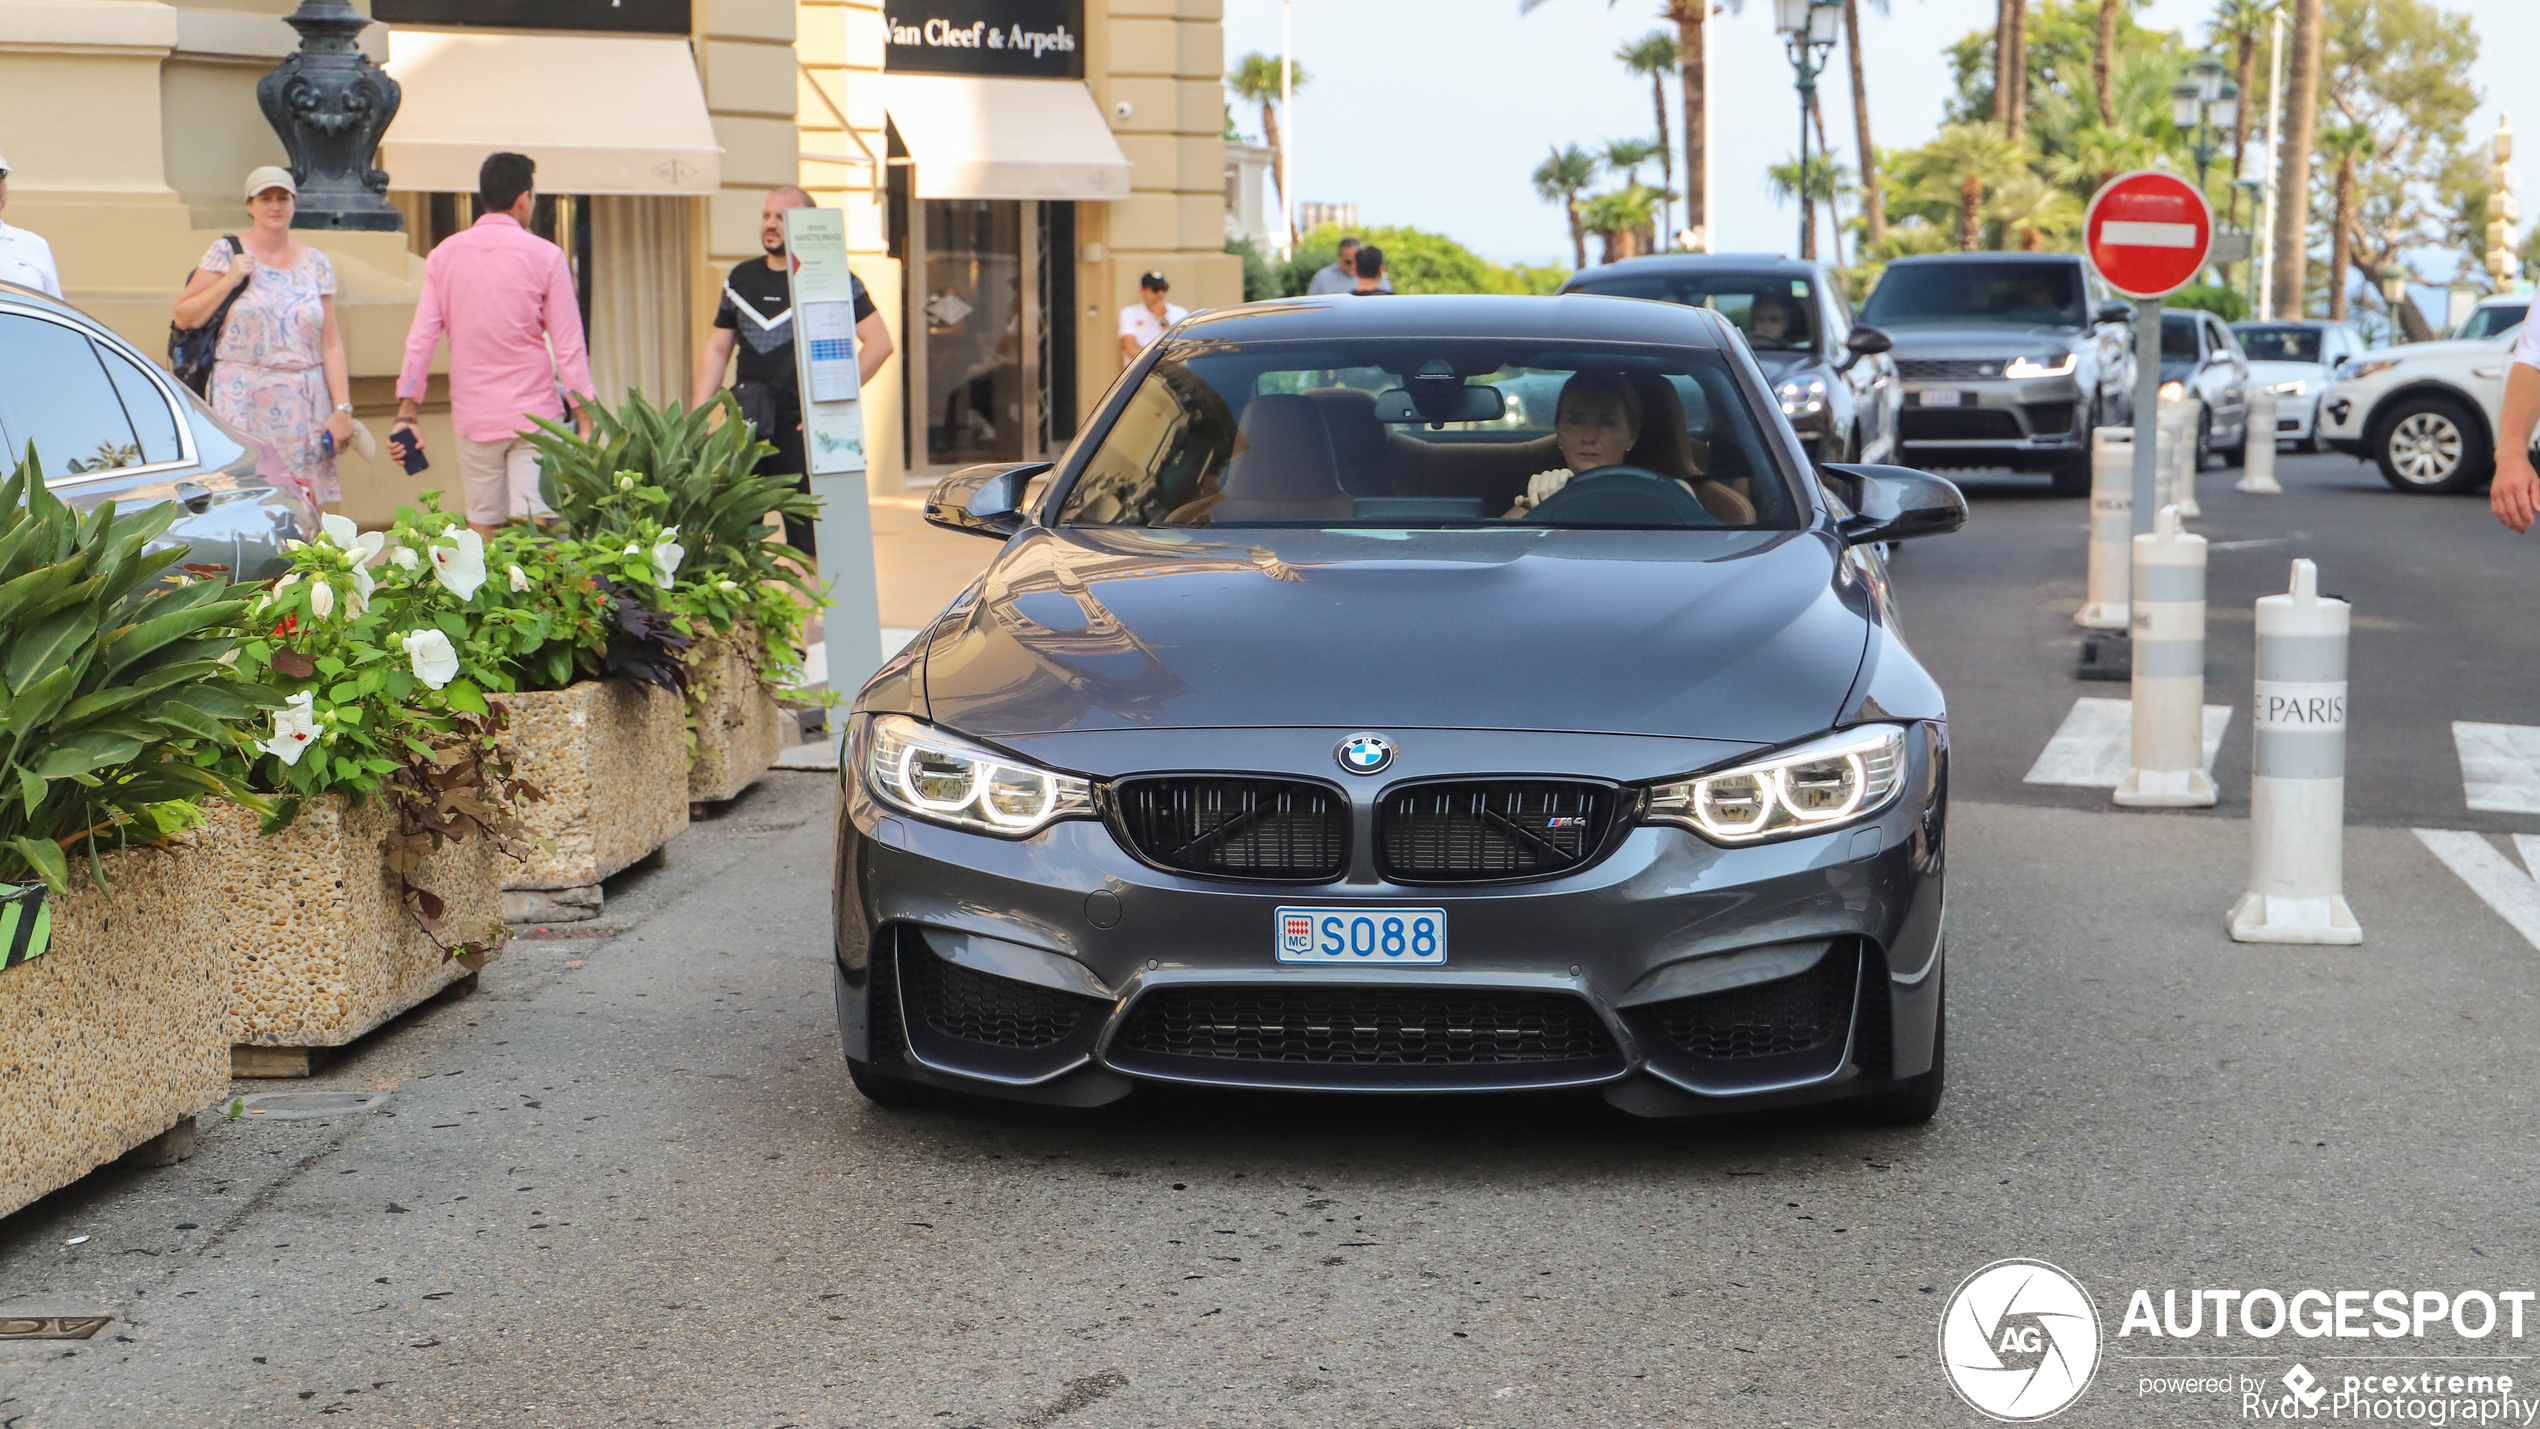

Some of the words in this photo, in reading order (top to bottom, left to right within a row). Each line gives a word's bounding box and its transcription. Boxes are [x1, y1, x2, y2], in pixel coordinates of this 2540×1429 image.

[883, 17, 922, 46] Van
[924, 18, 985, 48] Cleef
[987, 27, 1004, 49] &
[1007, 23, 1075, 58] Arpels
[2269, 696, 2343, 723] PARIS
[1345, 738, 1390, 750] BMW
[1559, 817, 1586, 828] M4
[1289, 936, 1307, 947] MC
[1321, 916, 1436, 957] S088
